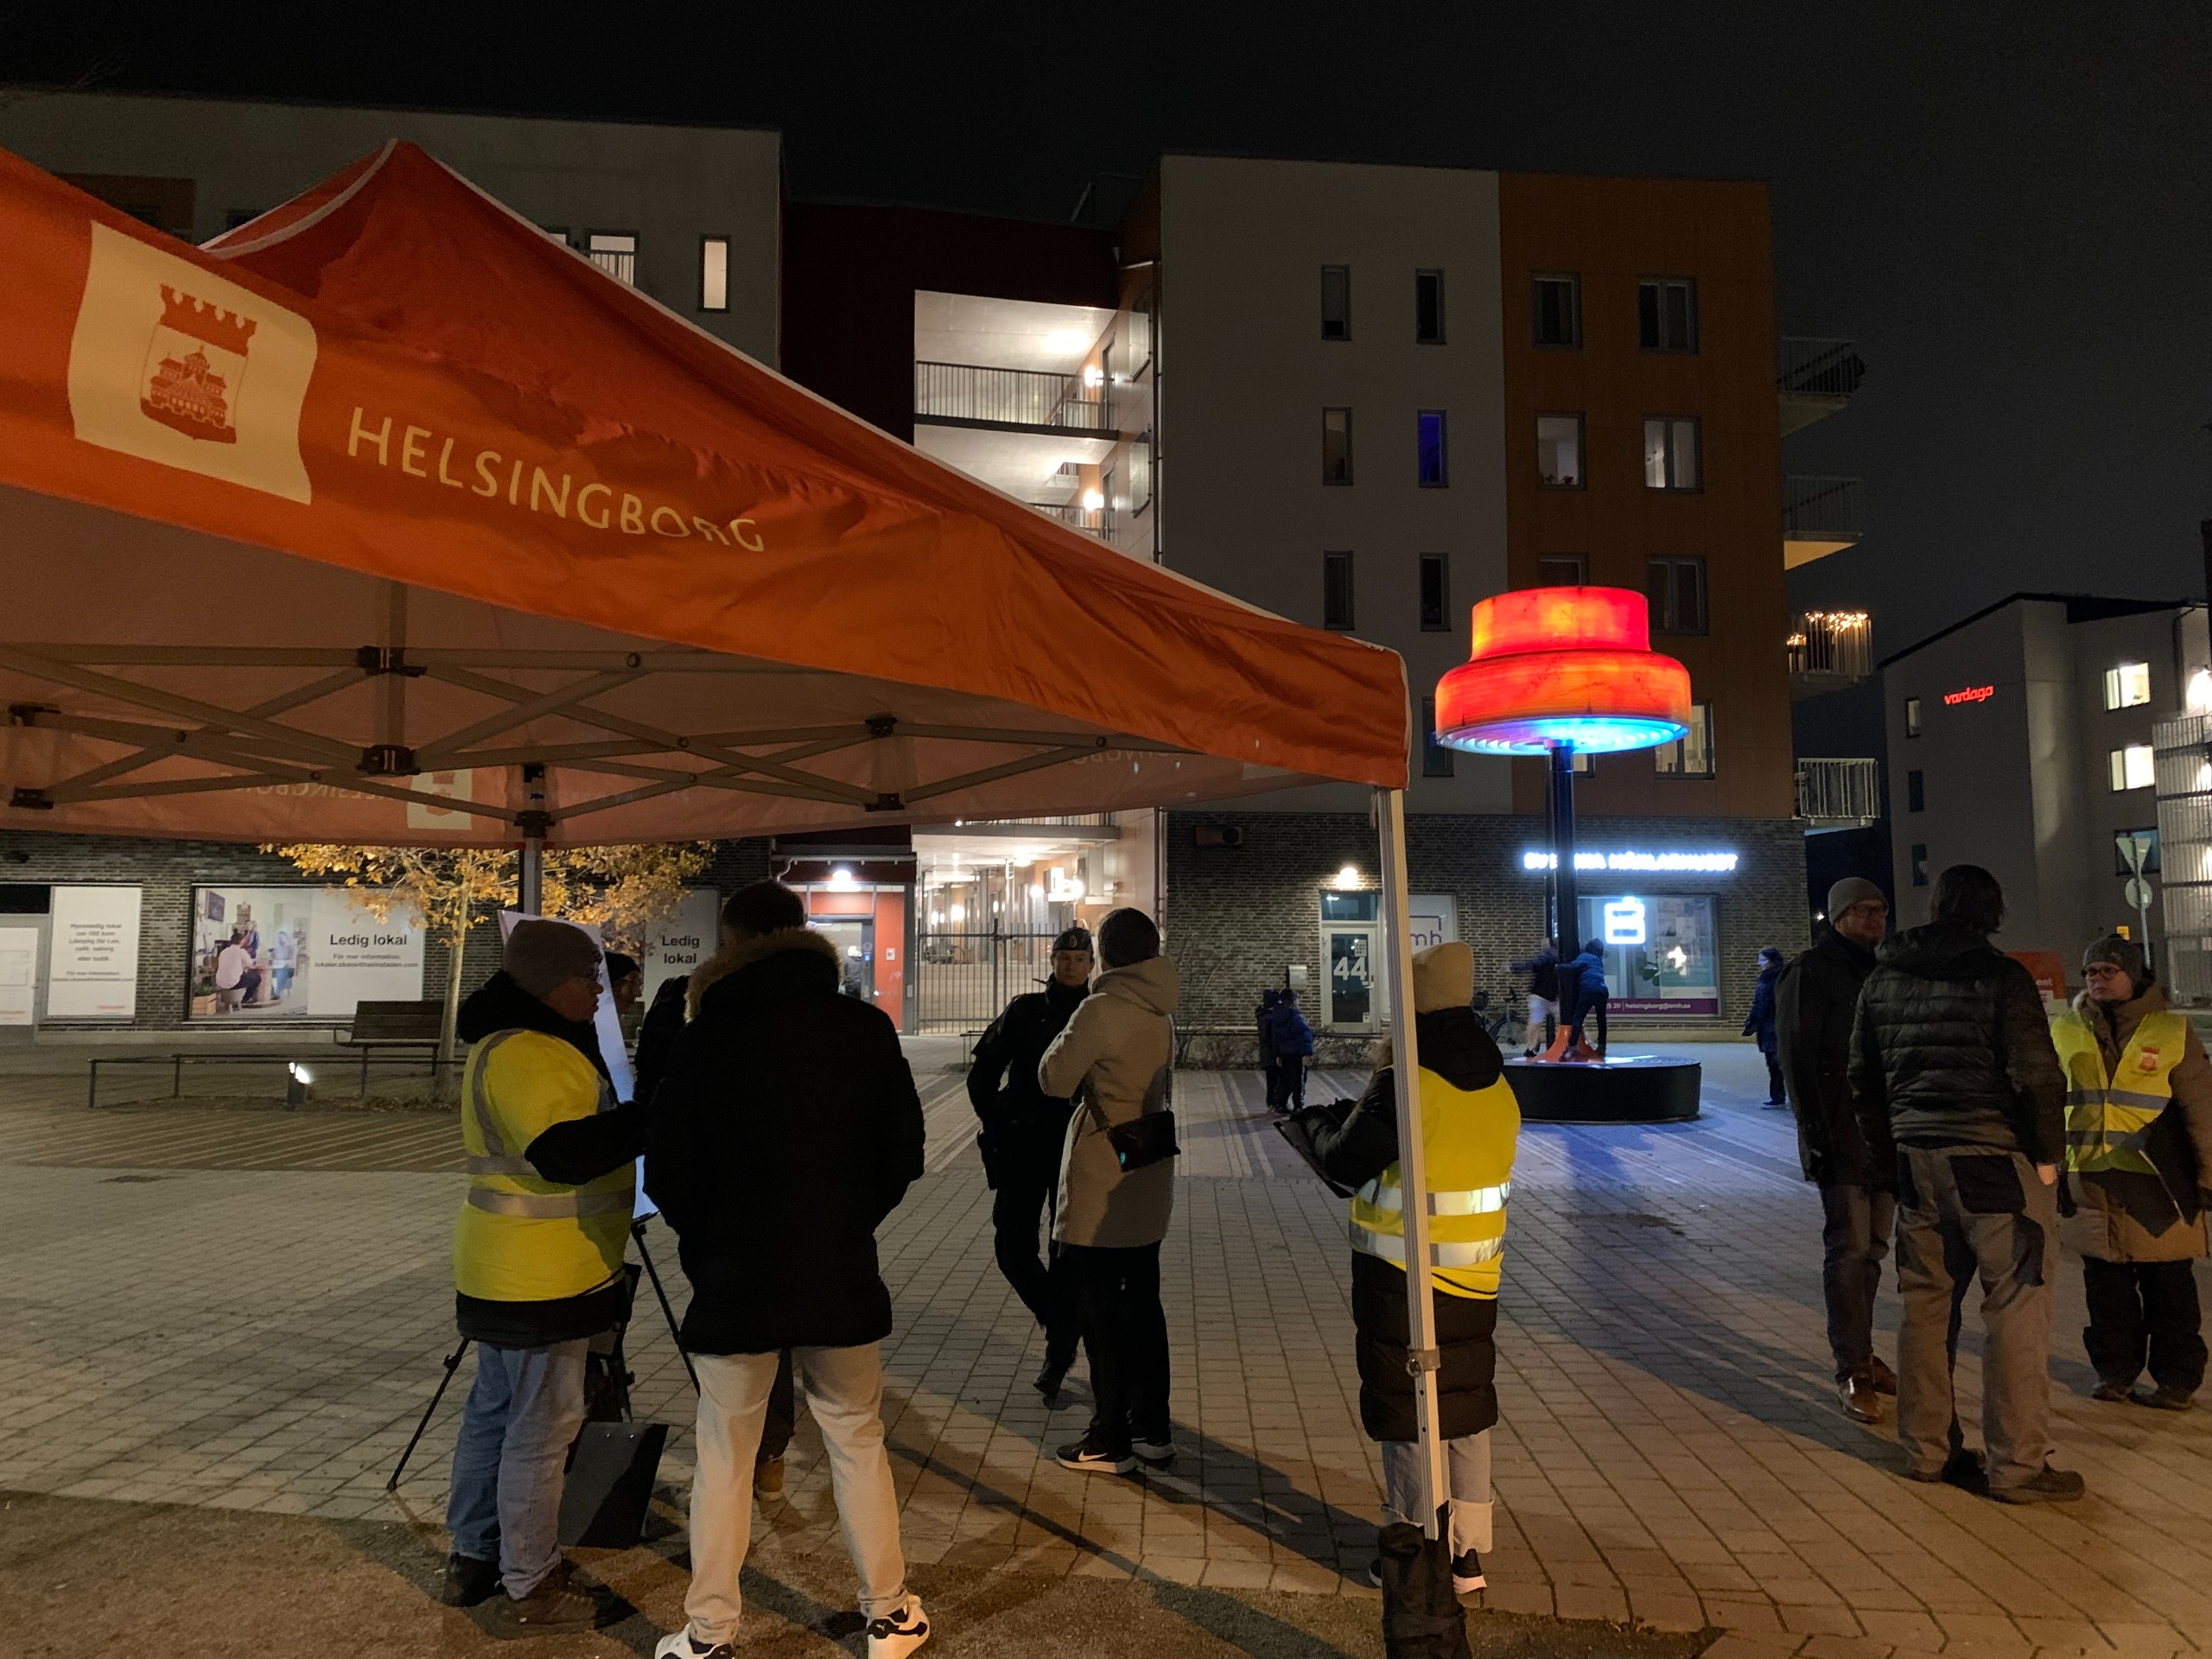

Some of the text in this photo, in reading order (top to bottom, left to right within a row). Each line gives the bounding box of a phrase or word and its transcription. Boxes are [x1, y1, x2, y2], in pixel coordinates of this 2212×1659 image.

[347, 406, 764, 553] HELSINGBORG
[330, 934, 407, 948] Ledig lokal
[662, 935, 700, 949] Ledig
[1410, 930, 1442, 946] mh
[664, 952, 697, 964] lokal
[1333, 957, 1367, 981] 44
